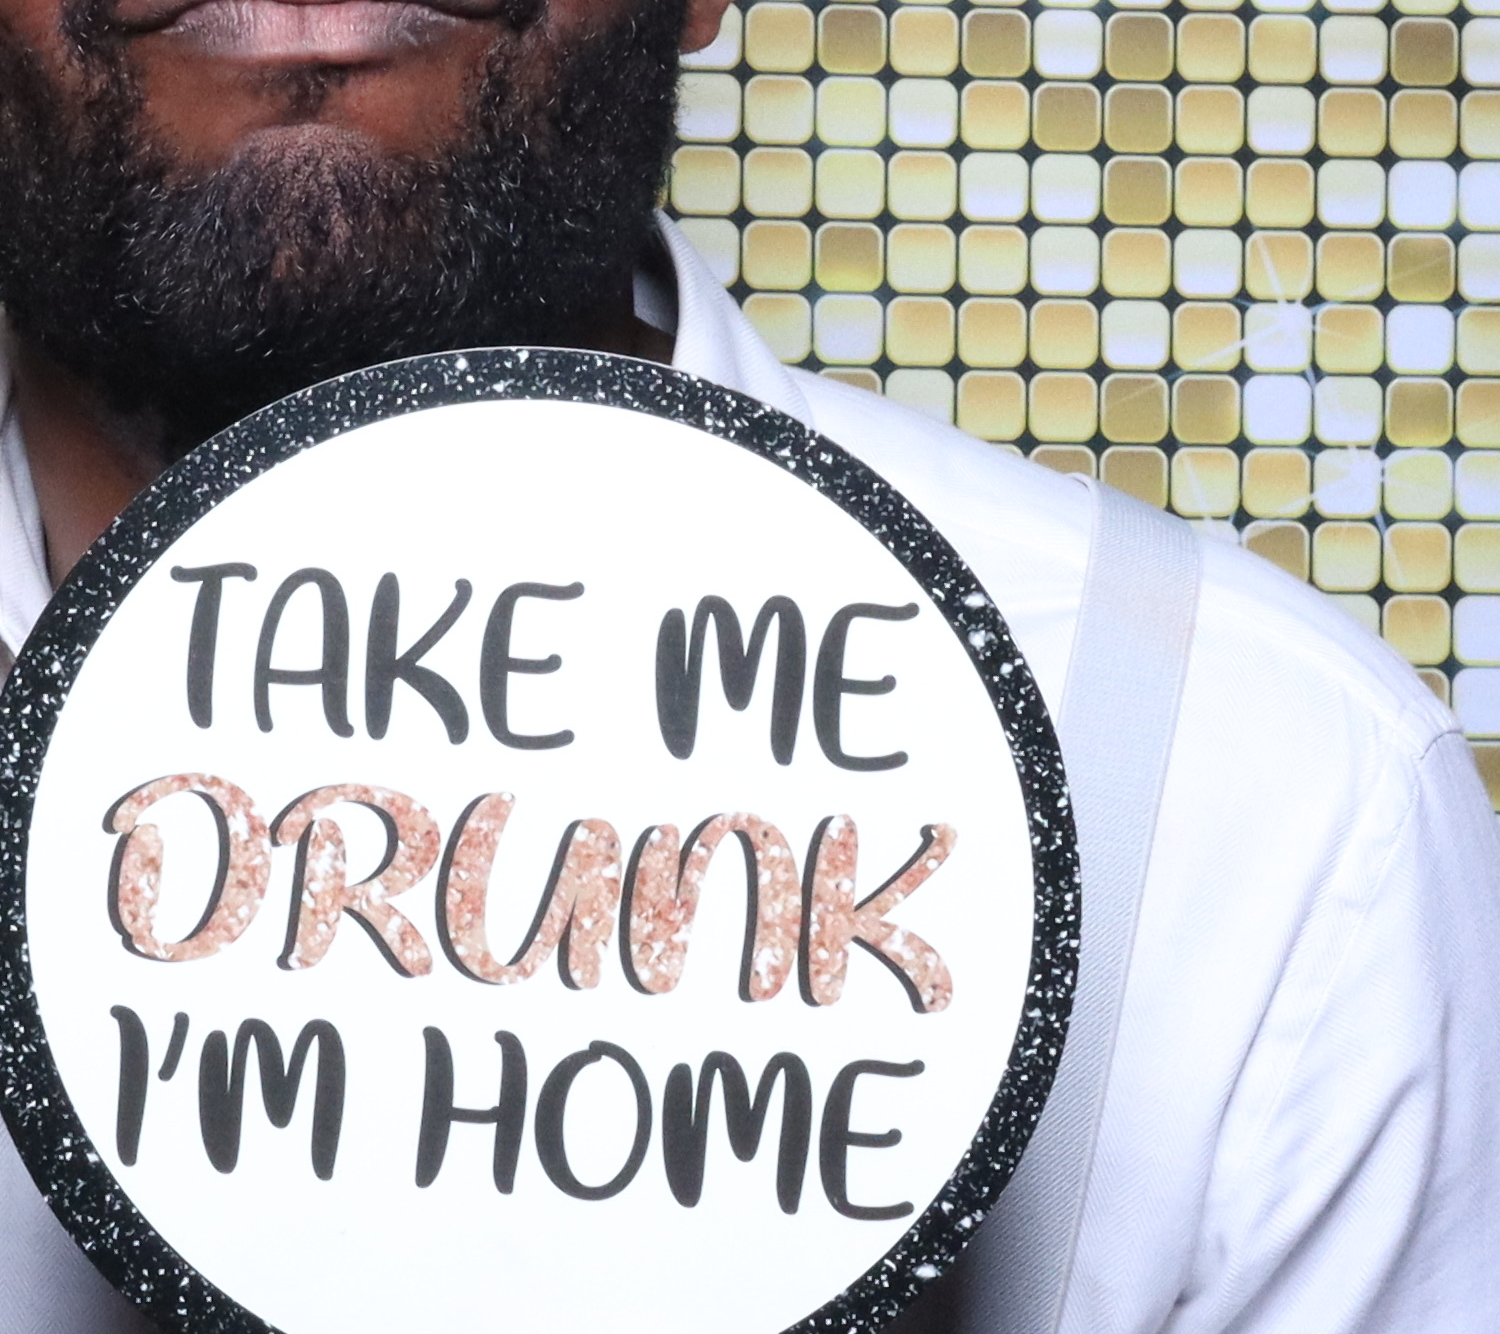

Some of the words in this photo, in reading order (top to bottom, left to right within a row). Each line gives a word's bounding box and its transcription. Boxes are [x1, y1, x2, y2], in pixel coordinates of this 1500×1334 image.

[170, 561, 585, 751] TAKE
[655, 593, 920, 773] ME
[101, 771, 959, 1015] DRUNK
[110, 1004, 348, 1183] I'M
[414, 1026, 926, 1223] HOME
